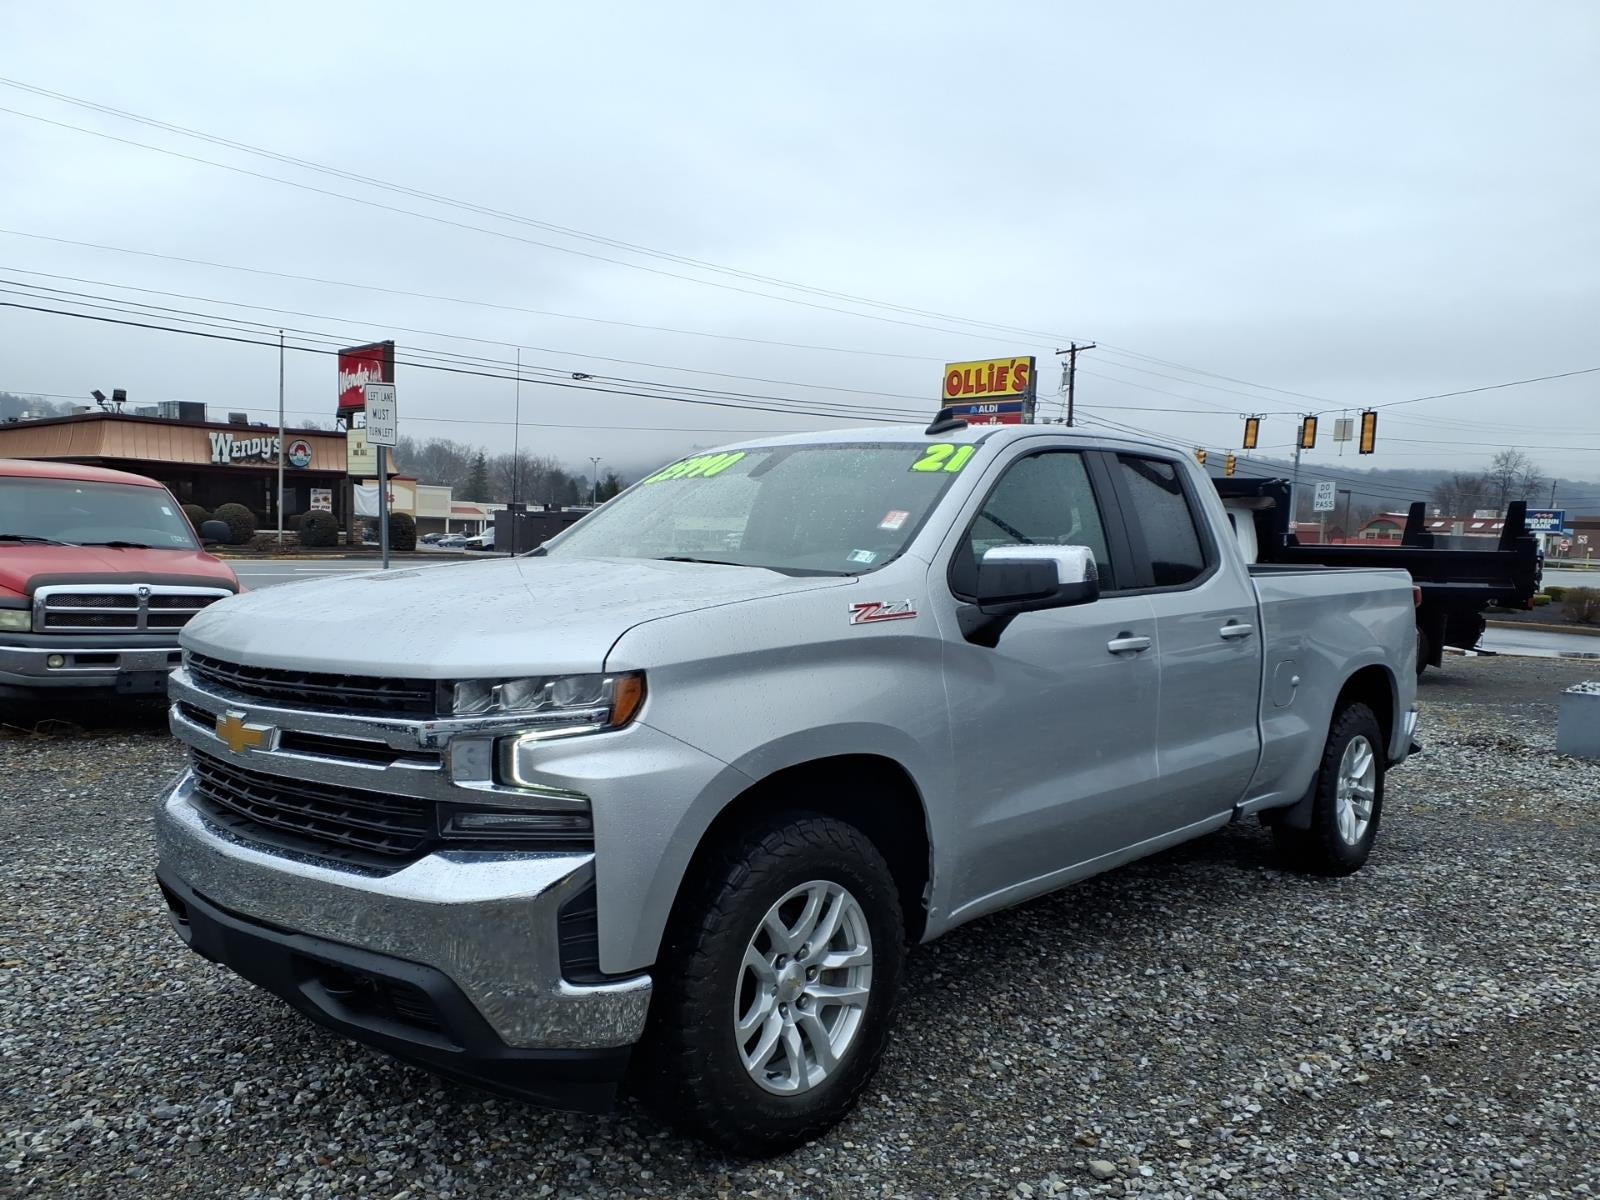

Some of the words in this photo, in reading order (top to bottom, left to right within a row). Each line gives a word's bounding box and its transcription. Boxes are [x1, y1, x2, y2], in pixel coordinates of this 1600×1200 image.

[340, 363, 369, 395] Wendy's
[946, 359, 1029, 396] OLLIE'S
[367, 391, 379, 401] LEFT
[380, 392, 394, 403] LANE
[372, 408, 390, 421] MUST
[978, 404, 998, 413] ALDI
[369, 426, 382, 437] TURN
[382, 428, 393, 438] LEFT
[209, 432, 280, 464] Wendy's
[911, 443, 976, 473] 21
[1320, 483, 1331, 491] DO
[1318, 492, 1332, 500] NOT
[1315, 501, 1334, 509] PASS
[848, 598, 918, 625] Z71
